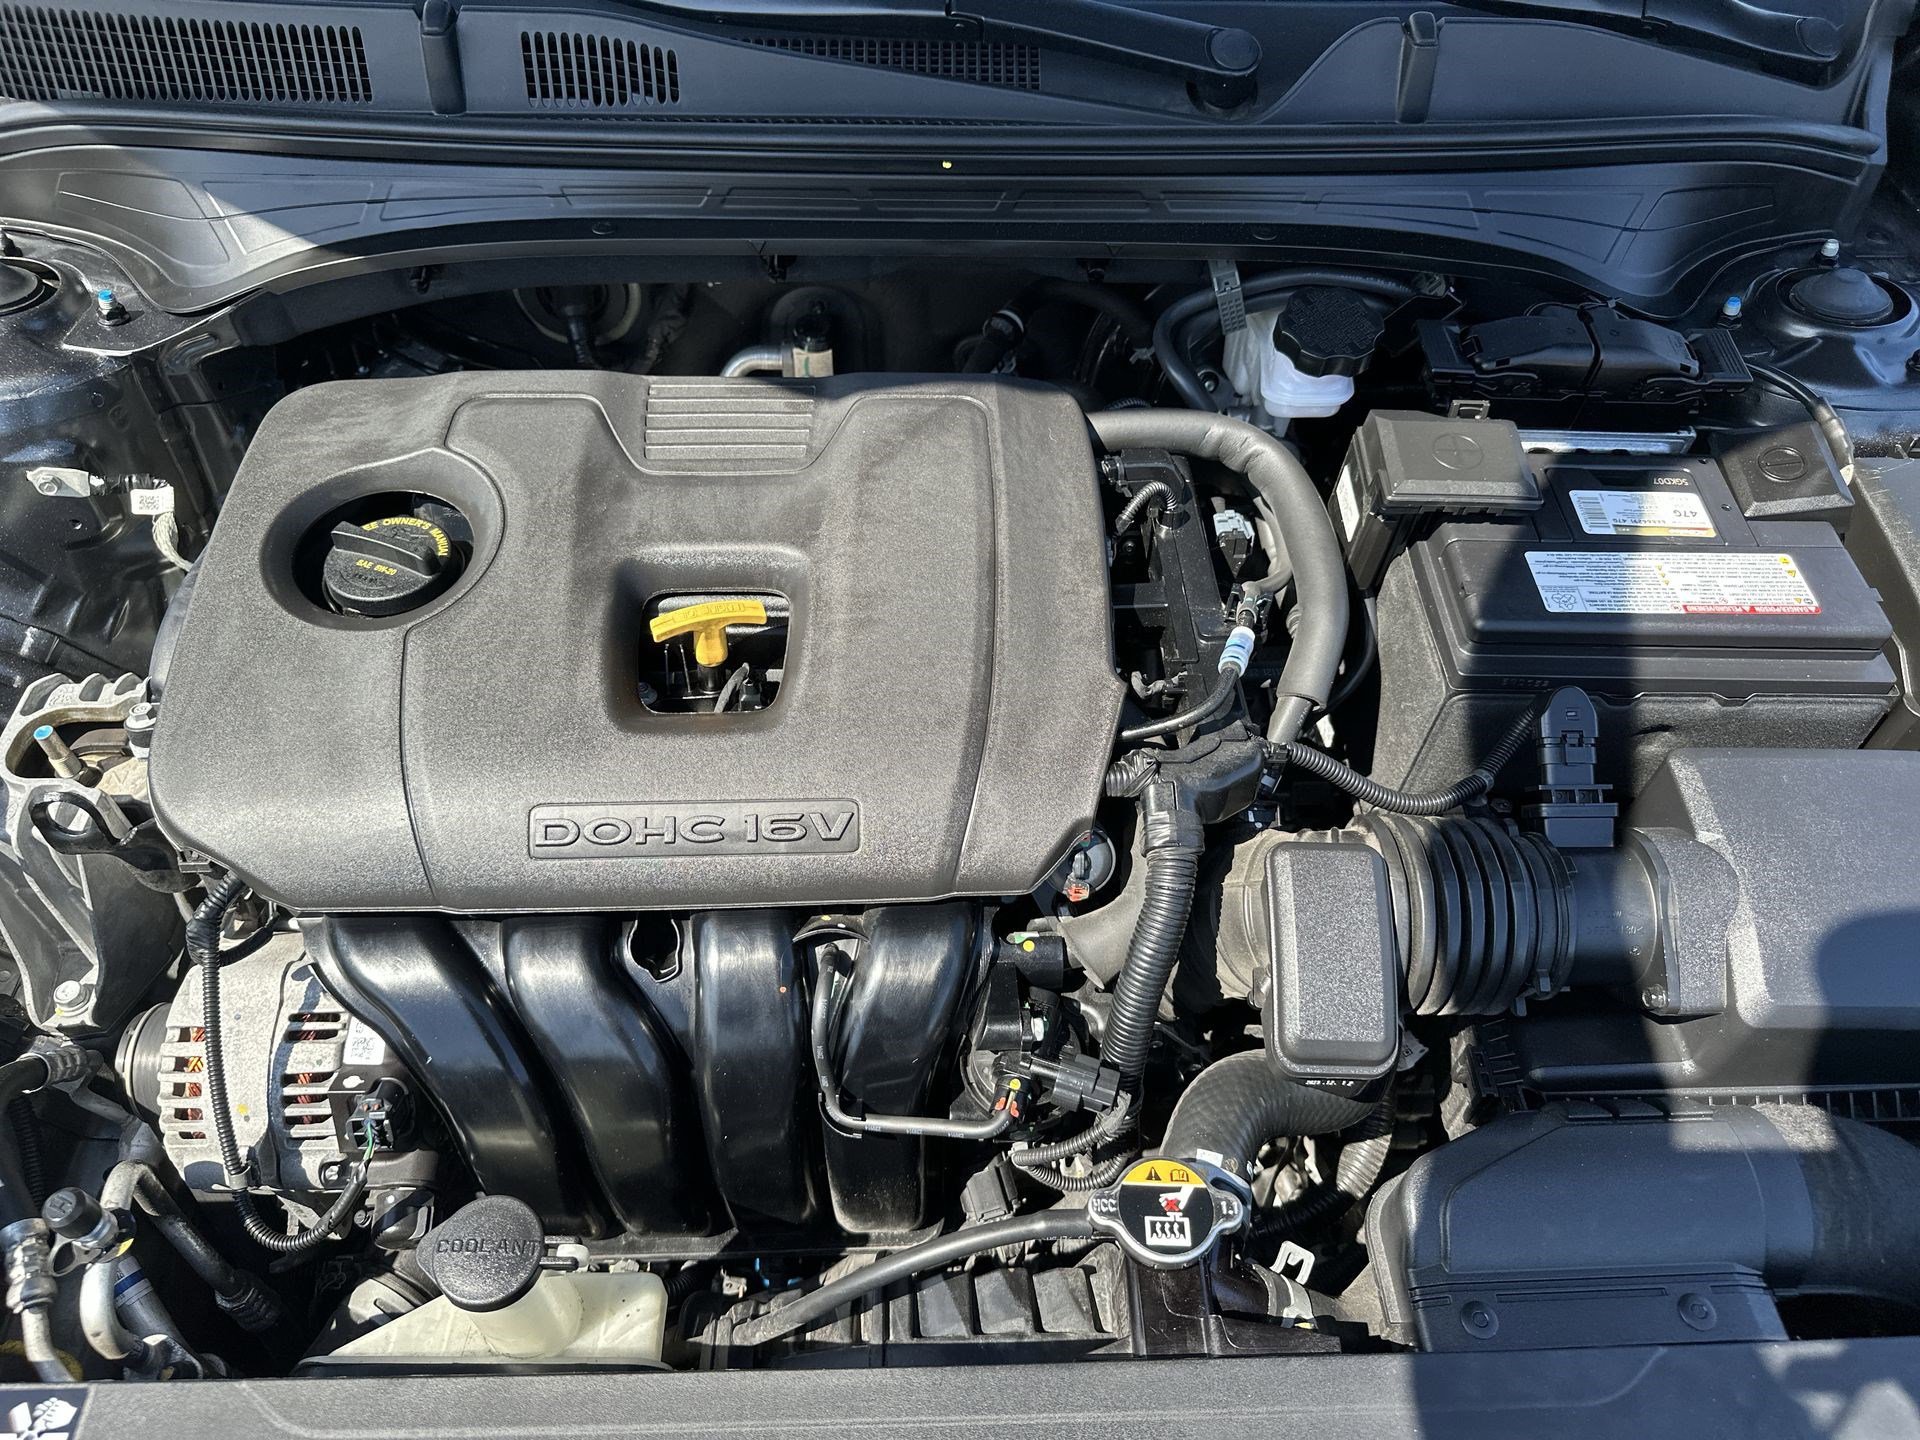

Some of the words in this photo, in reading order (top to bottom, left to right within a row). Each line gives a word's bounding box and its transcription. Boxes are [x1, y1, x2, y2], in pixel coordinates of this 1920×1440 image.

[1672, 508, 1698, 519] 47G
[382, 517, 432, 530] OWNER'S
[355, 559, 374, 569] SAE
[534, 814, 726, 848] DOHC
[744, 811, 855, 843] 16V
[1092, 1198, 1117, 1212] HCC
[1220, 1200, 1239, 1215] 1.1
[437, 1238, 541, 1257] COOLANT
